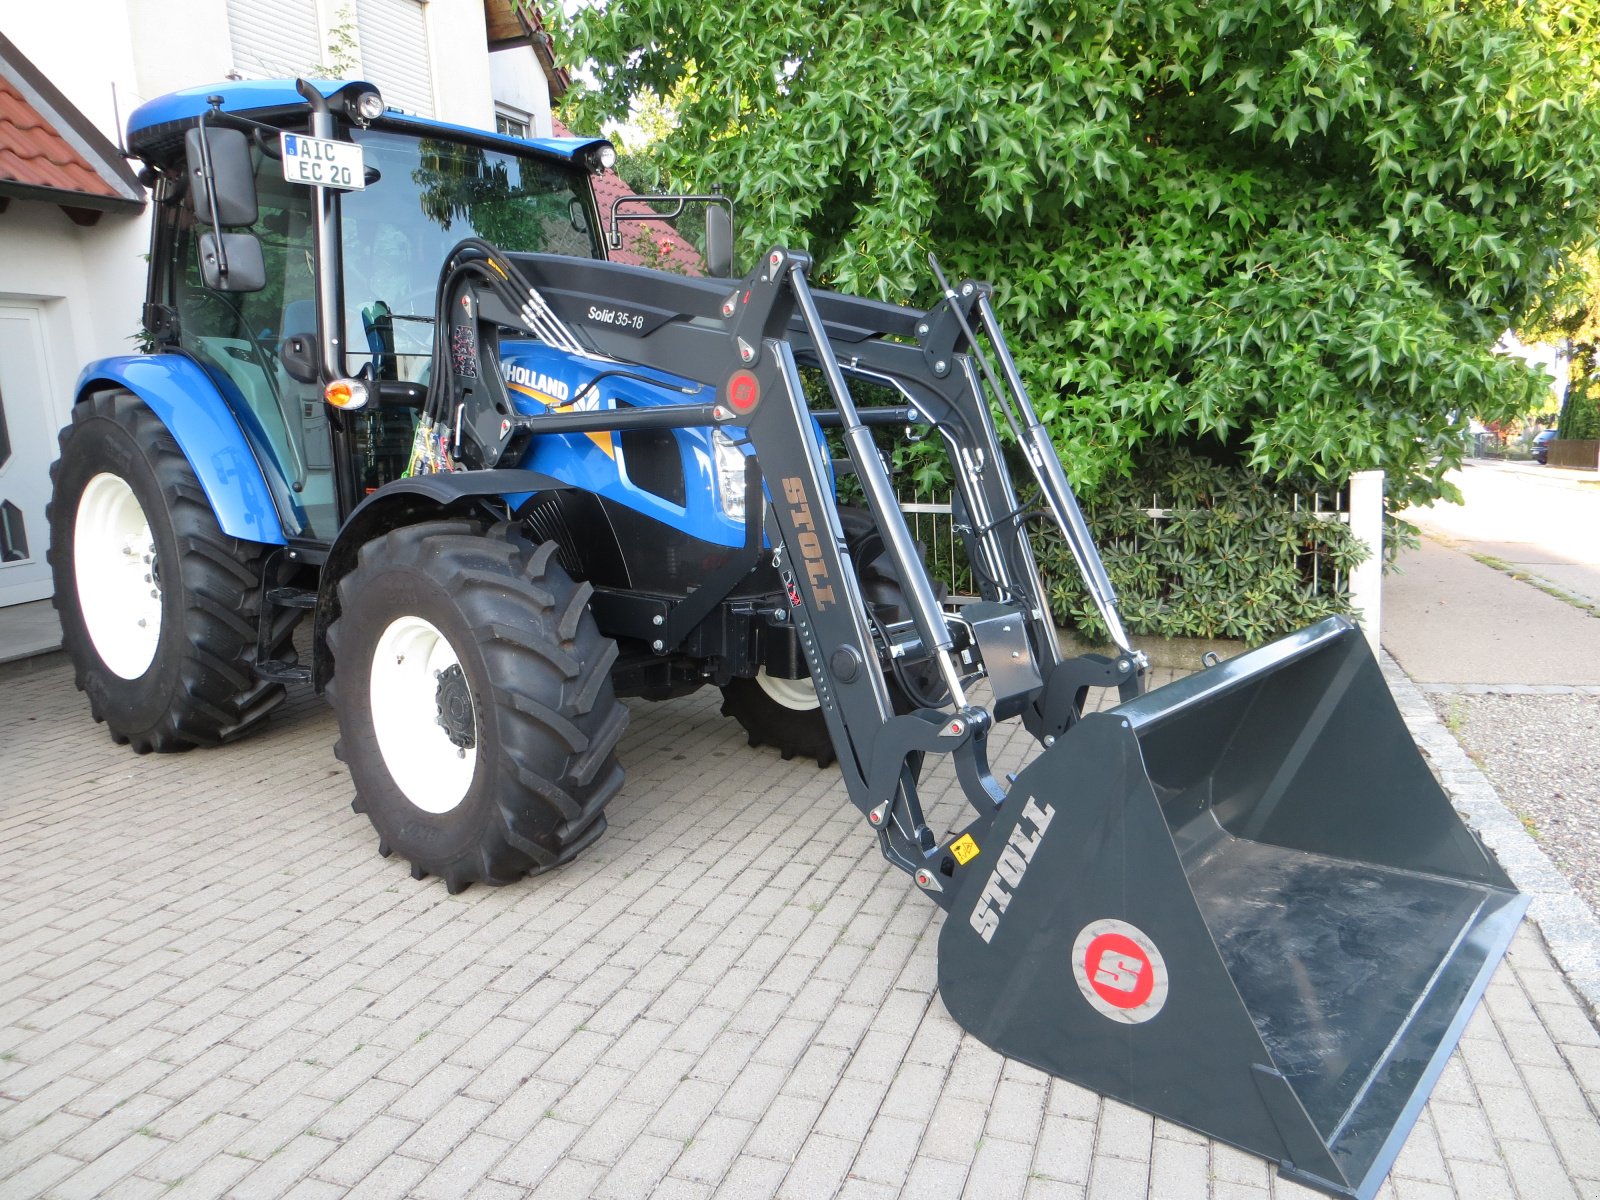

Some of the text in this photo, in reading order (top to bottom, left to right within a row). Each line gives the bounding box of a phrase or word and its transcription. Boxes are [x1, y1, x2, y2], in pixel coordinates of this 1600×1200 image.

[301, 140, 335, 162] AIC
[299, 161, 351, 185] EC 20
[588, 306, 644, 329] Solid 35-18
[507, 364, 569, 401] HOLLAND
[781, 477, 836, 611] STOLL
[969, 795, 1056, 944] STOLL
[1094, 949, 1143, 993] S
